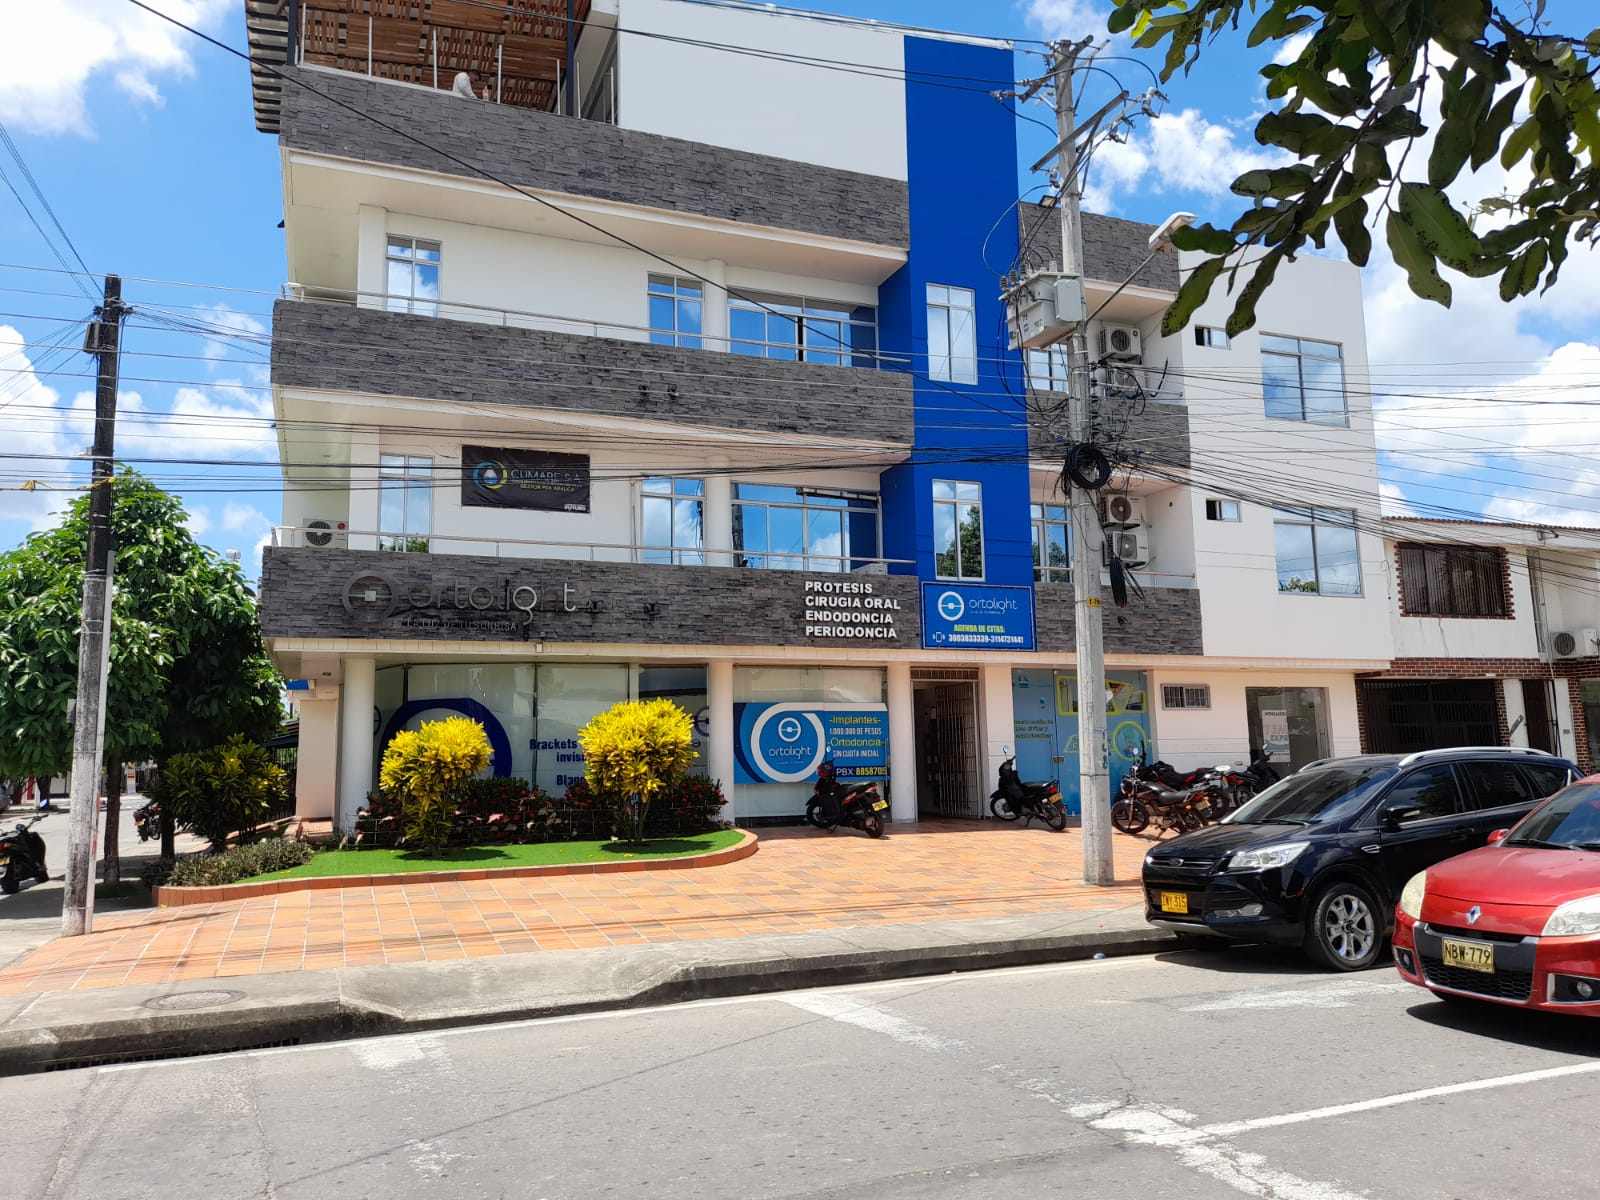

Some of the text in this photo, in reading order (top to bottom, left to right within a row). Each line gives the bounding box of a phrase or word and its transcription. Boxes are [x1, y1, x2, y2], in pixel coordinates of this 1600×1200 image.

[804, 581, 873, 594] PROTESIS
[805, 595, 901, 610] CIRUGIA ORAL
[968, 597, 1018, 615] ortolight
[805, 610, 894, 624] ENDODONCIA
[805, 625, 897, 638] PERIODONCIA
[864, 727, 882, 735] PESOS
[529, 738, 578, 749] Brackets
[768, 745, 812, 760] ortolight
